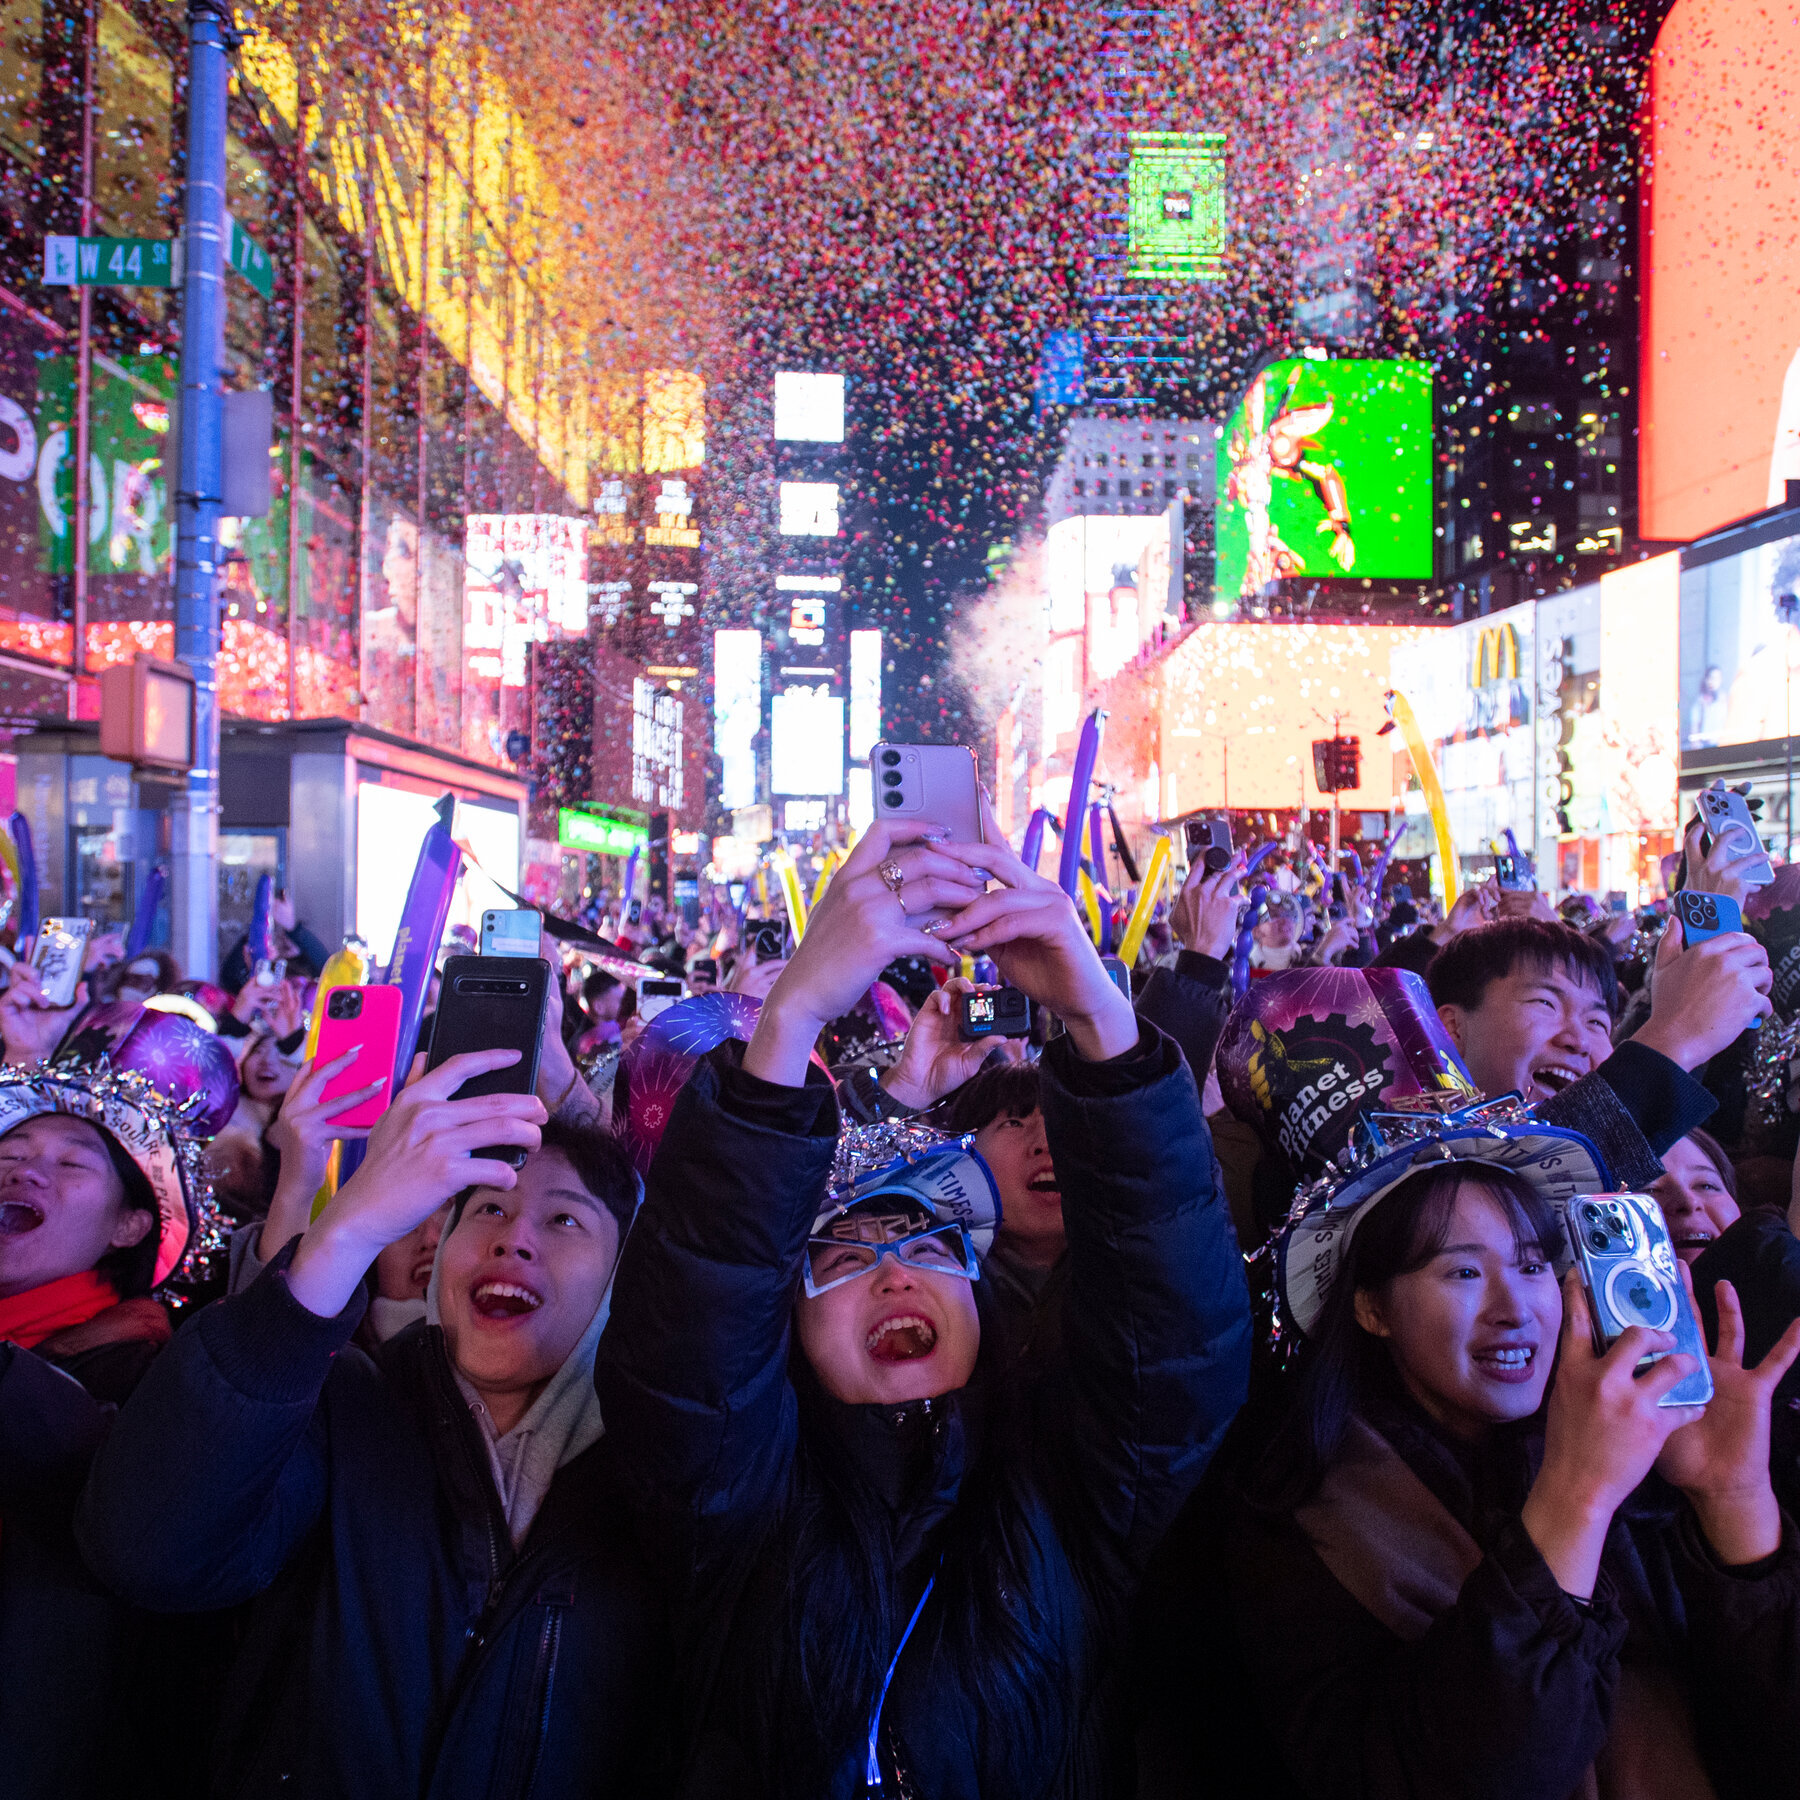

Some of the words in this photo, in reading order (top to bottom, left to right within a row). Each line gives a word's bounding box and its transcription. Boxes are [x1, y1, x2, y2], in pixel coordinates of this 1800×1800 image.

[81, 243, 99, 279] W
[108, 243, 142, 279] 44
[1280, 1061, 1350, 1159] planet
[1290, 1068, 1384, 1162] fitness
[937, 1170, 974, 1217] TIMES
[1314, 1248, 1334, 1300] TIMES
